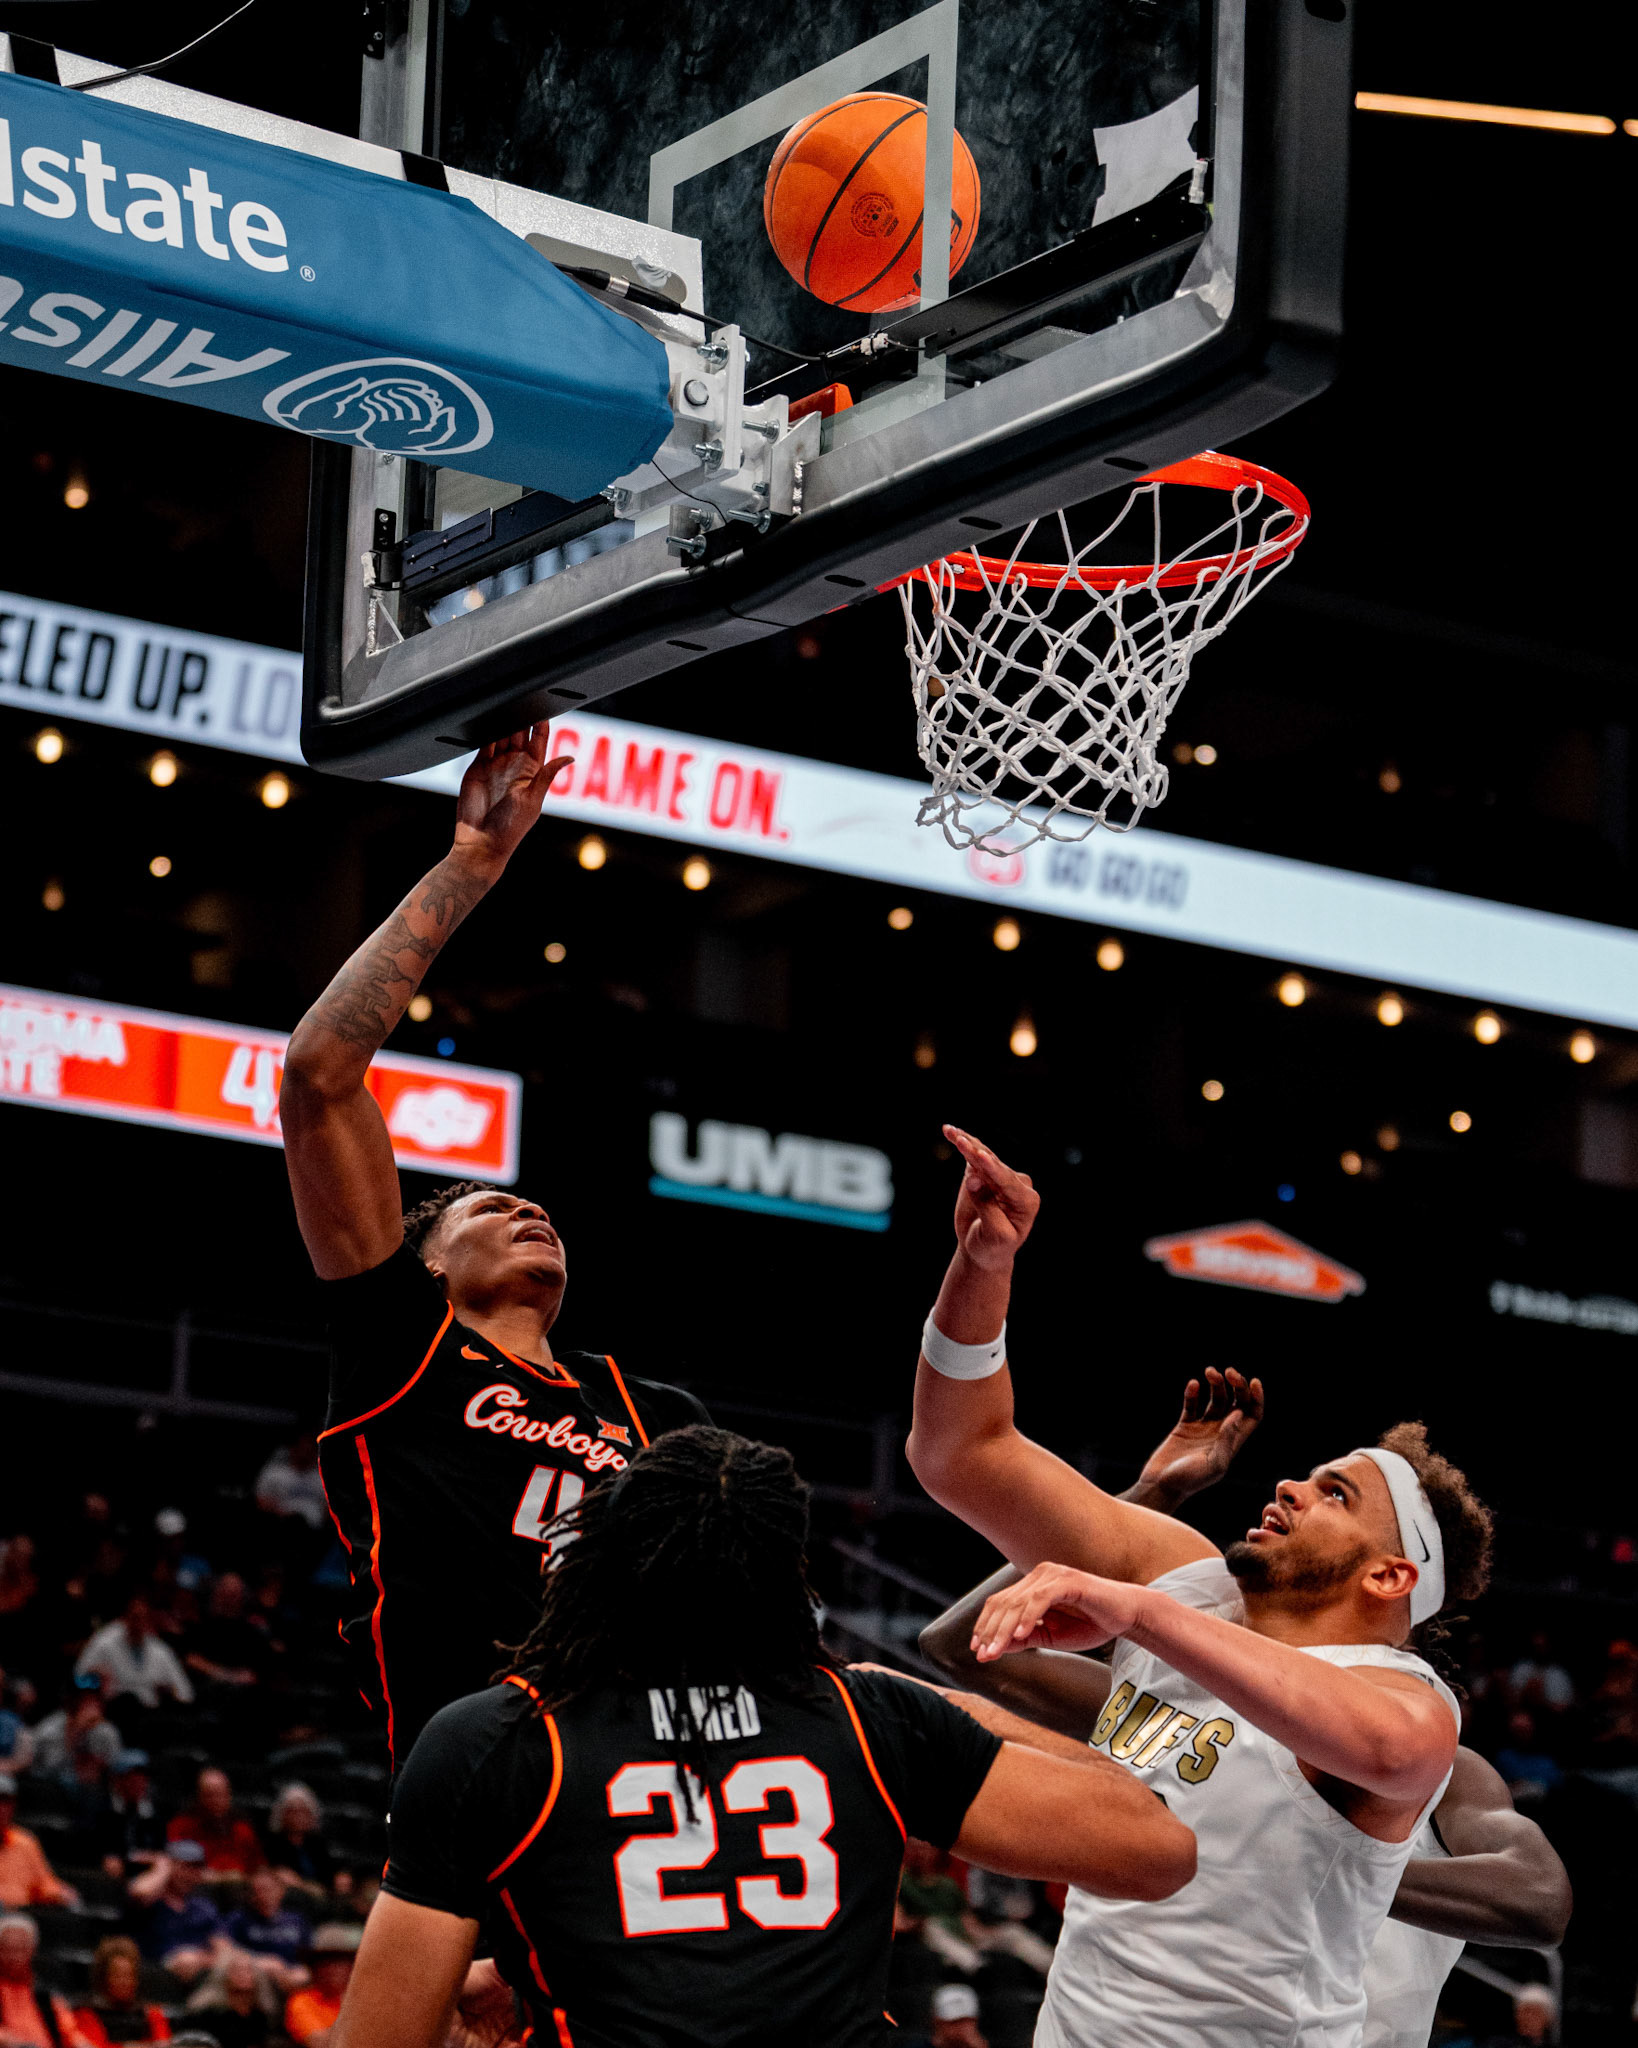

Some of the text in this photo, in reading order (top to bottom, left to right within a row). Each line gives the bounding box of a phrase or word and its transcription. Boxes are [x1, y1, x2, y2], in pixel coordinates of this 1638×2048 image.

[134, 642, 208, 725] UP.
[549, 728, 693, 820] GAME
[709, 761, 788, 840] ON.
[0, 1050, 59, 1098] TE
[650, 1111, 895, 1213] UMB
[1088, 1679, 1235, 1785] BUFS
[606, 1755, 841, 1938] 23
